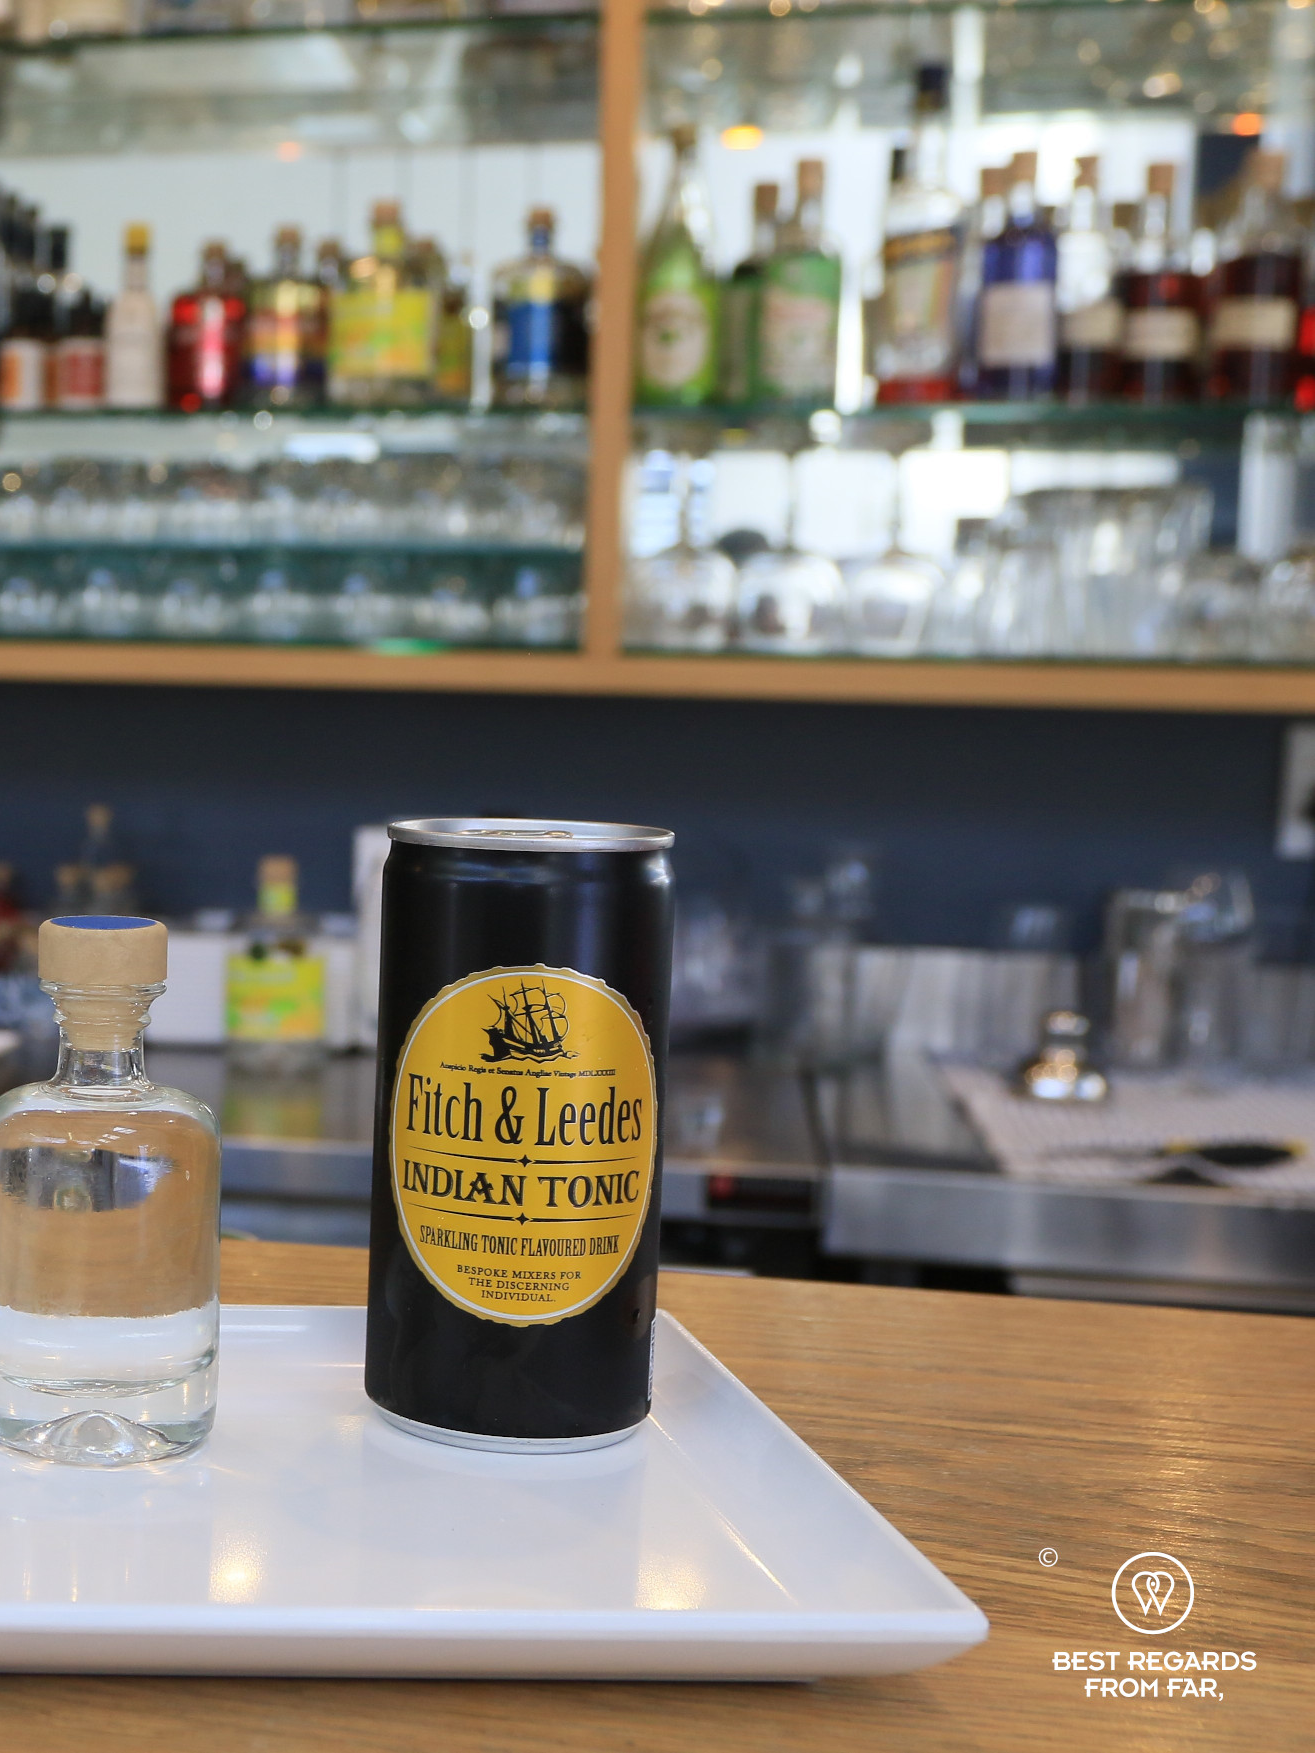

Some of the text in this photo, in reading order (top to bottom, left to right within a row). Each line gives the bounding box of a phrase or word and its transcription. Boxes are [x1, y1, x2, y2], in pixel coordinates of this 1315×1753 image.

[406, 1073, 642, 1146] Fitch & Leedes
[403, 1159, 640, 1208] INDIAN TONIC
[420, 1225, 620, 1257] SPARKLING TONIC FLAVOURED DRINK
[457, 1264, 581, 1280] BESPOKE MIXERS FOR
[468, 1277, 570, 1291] THE DISCERNING
[481, 1289, 556, 1303] INDIVIDUAL.
